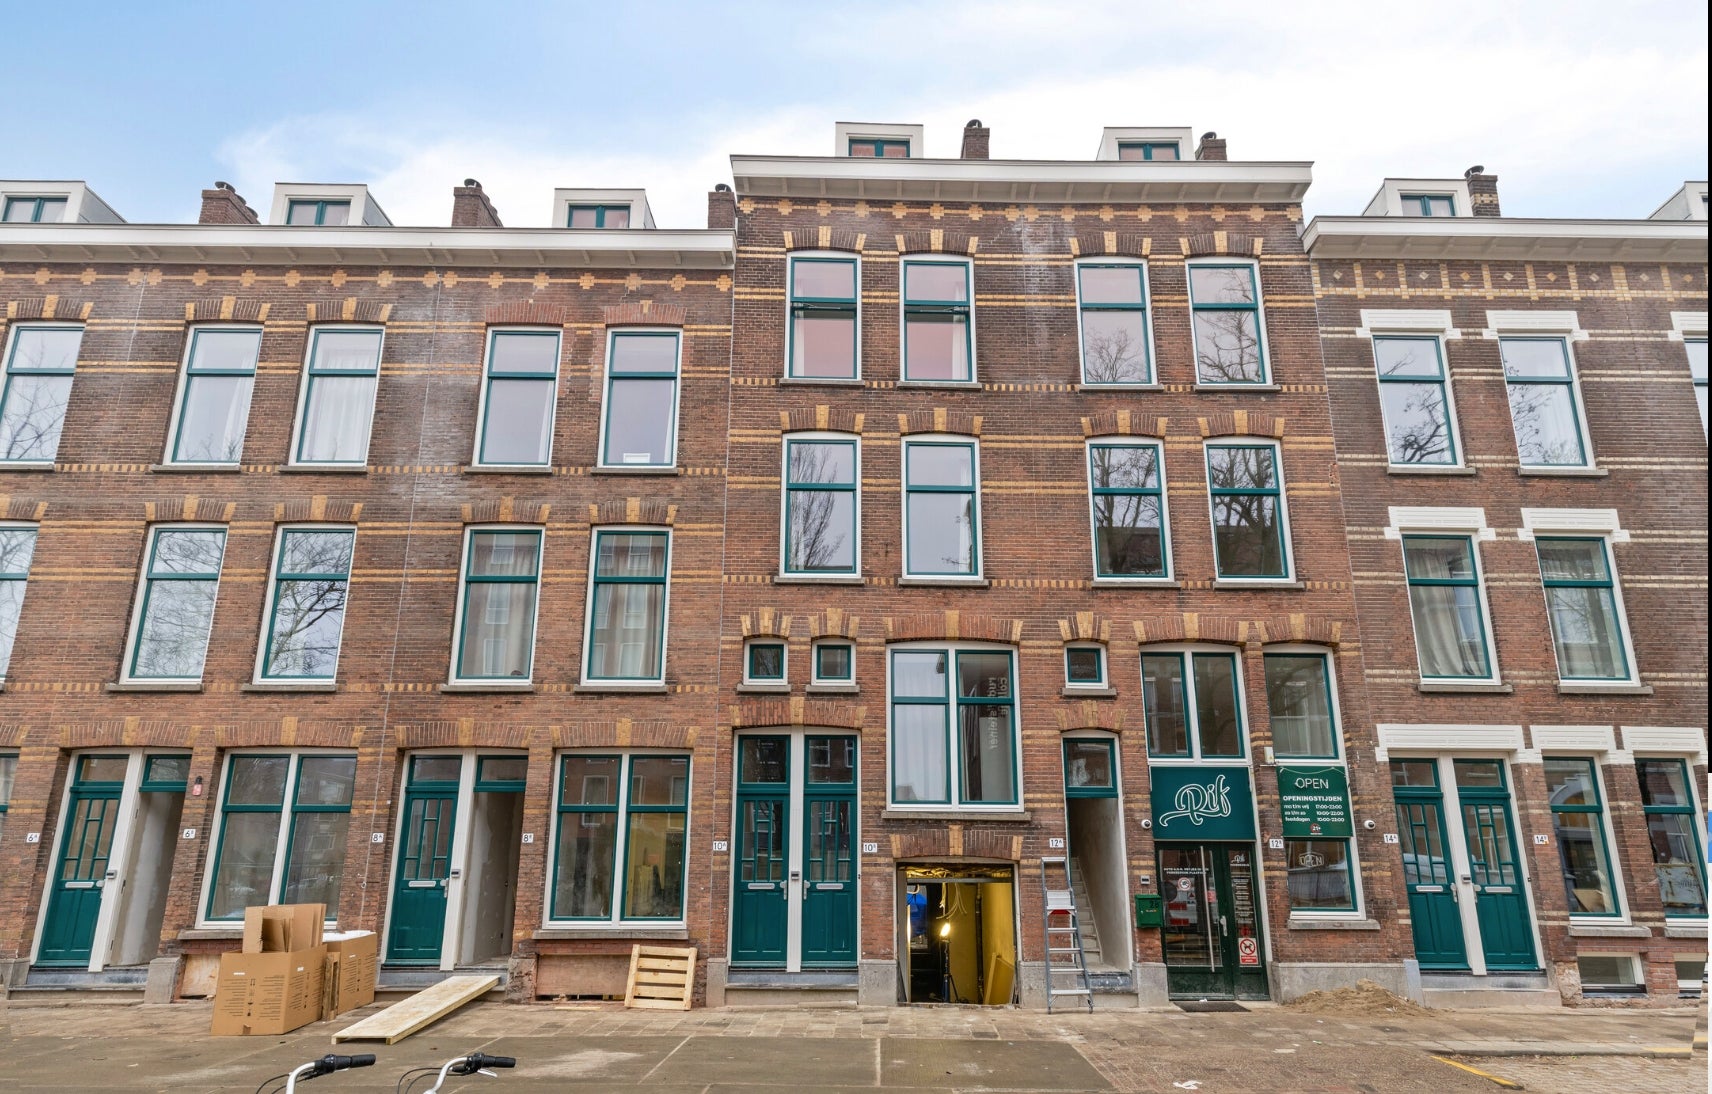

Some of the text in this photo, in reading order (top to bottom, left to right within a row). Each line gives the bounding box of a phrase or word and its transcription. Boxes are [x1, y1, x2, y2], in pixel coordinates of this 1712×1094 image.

[1295, 778, 1329, 789] OPEN
[1159, 774, 1232, 827] Rif
[1300, 854, 1322, 867] OPEN
